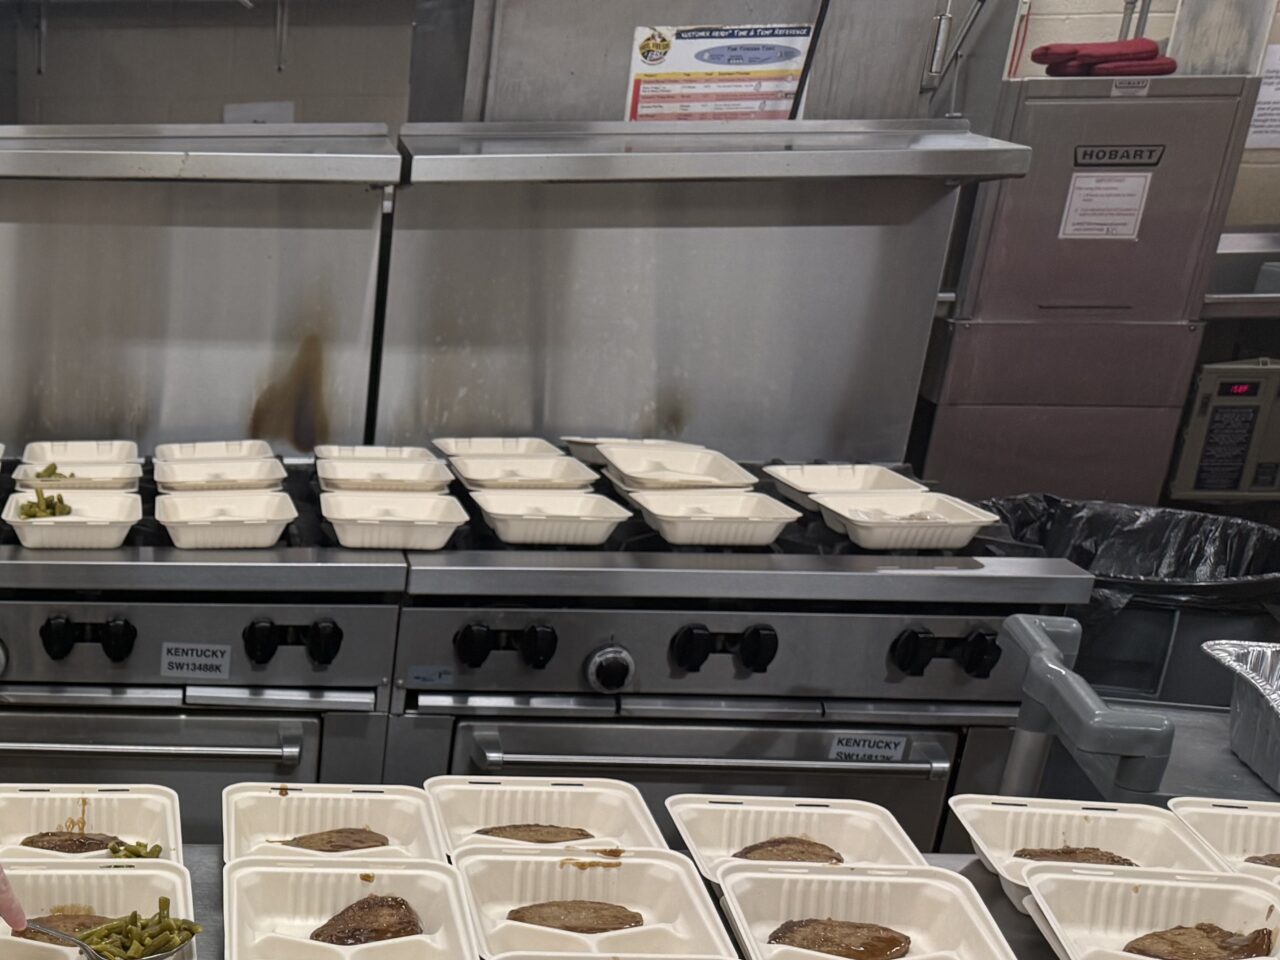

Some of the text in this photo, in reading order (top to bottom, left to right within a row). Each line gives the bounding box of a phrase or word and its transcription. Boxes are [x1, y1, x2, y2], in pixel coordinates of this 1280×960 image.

[1082, 149, 1157, 161] HOBART
[166, 647, 227, 659] KENTUCKY
[167, 661, 223, 673] SW13488K
[836, 737, 901, 751] KENTUCKY
